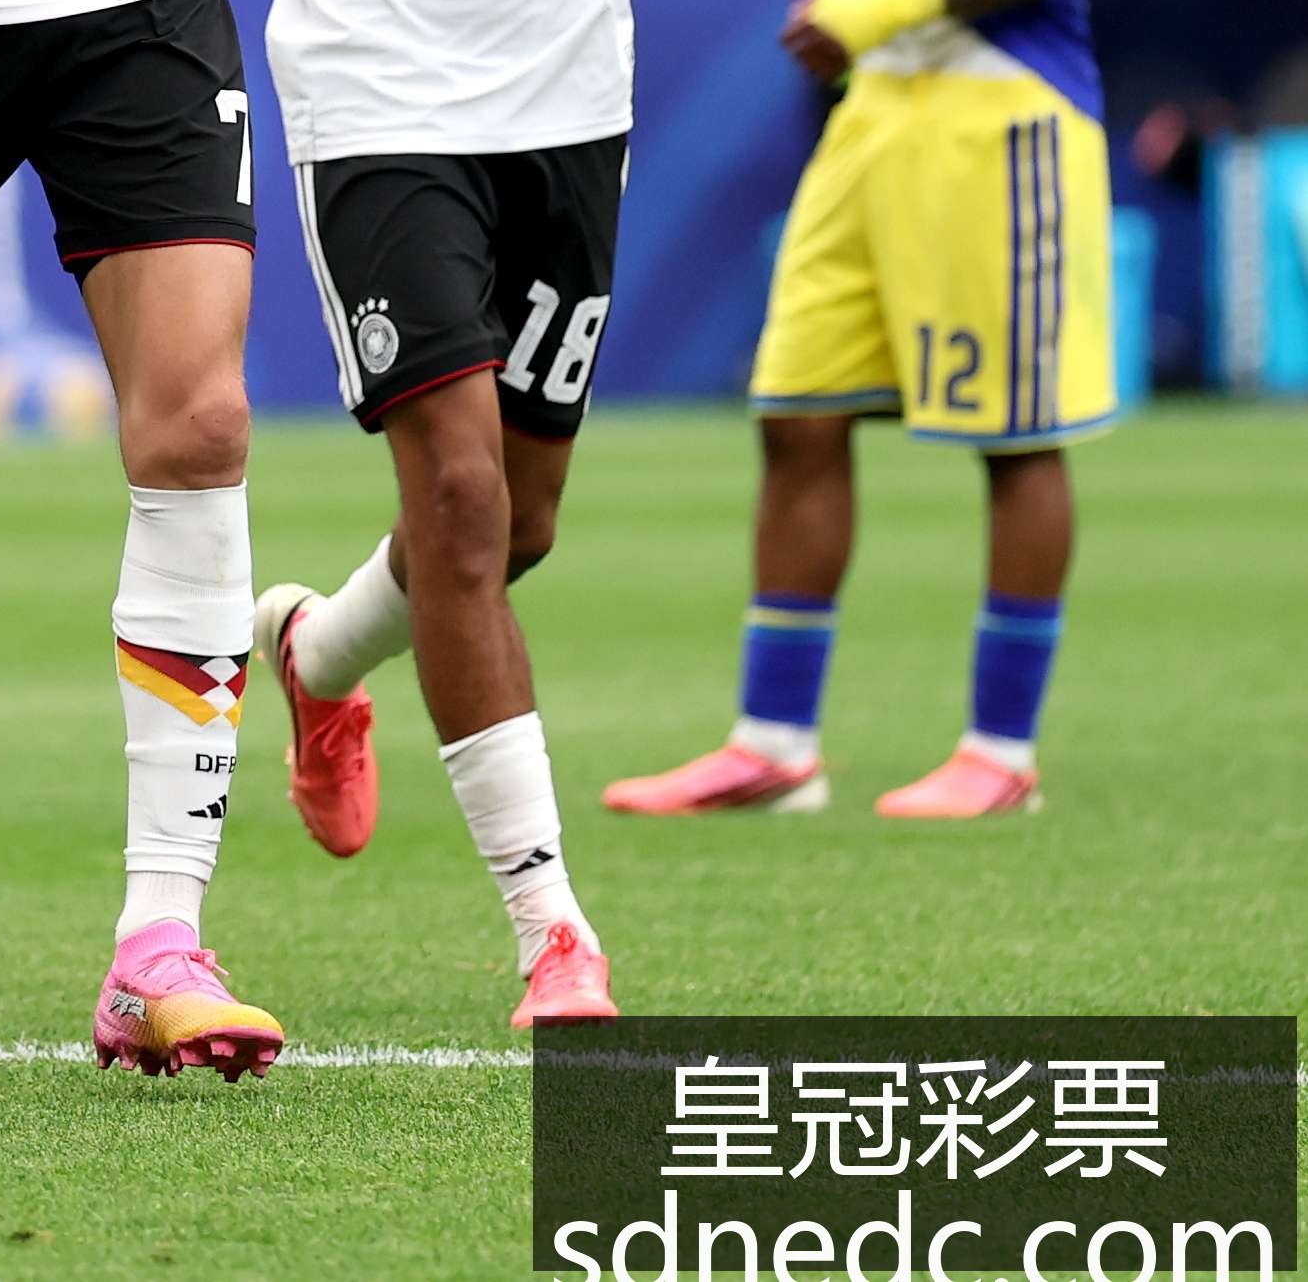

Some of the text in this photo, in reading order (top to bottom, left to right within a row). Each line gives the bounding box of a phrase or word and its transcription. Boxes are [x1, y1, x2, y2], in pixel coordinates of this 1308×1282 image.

[215, 89, 252, 206] 7
[498, 279, 611, 405] 18
[916, 324, 982, 412] 12
